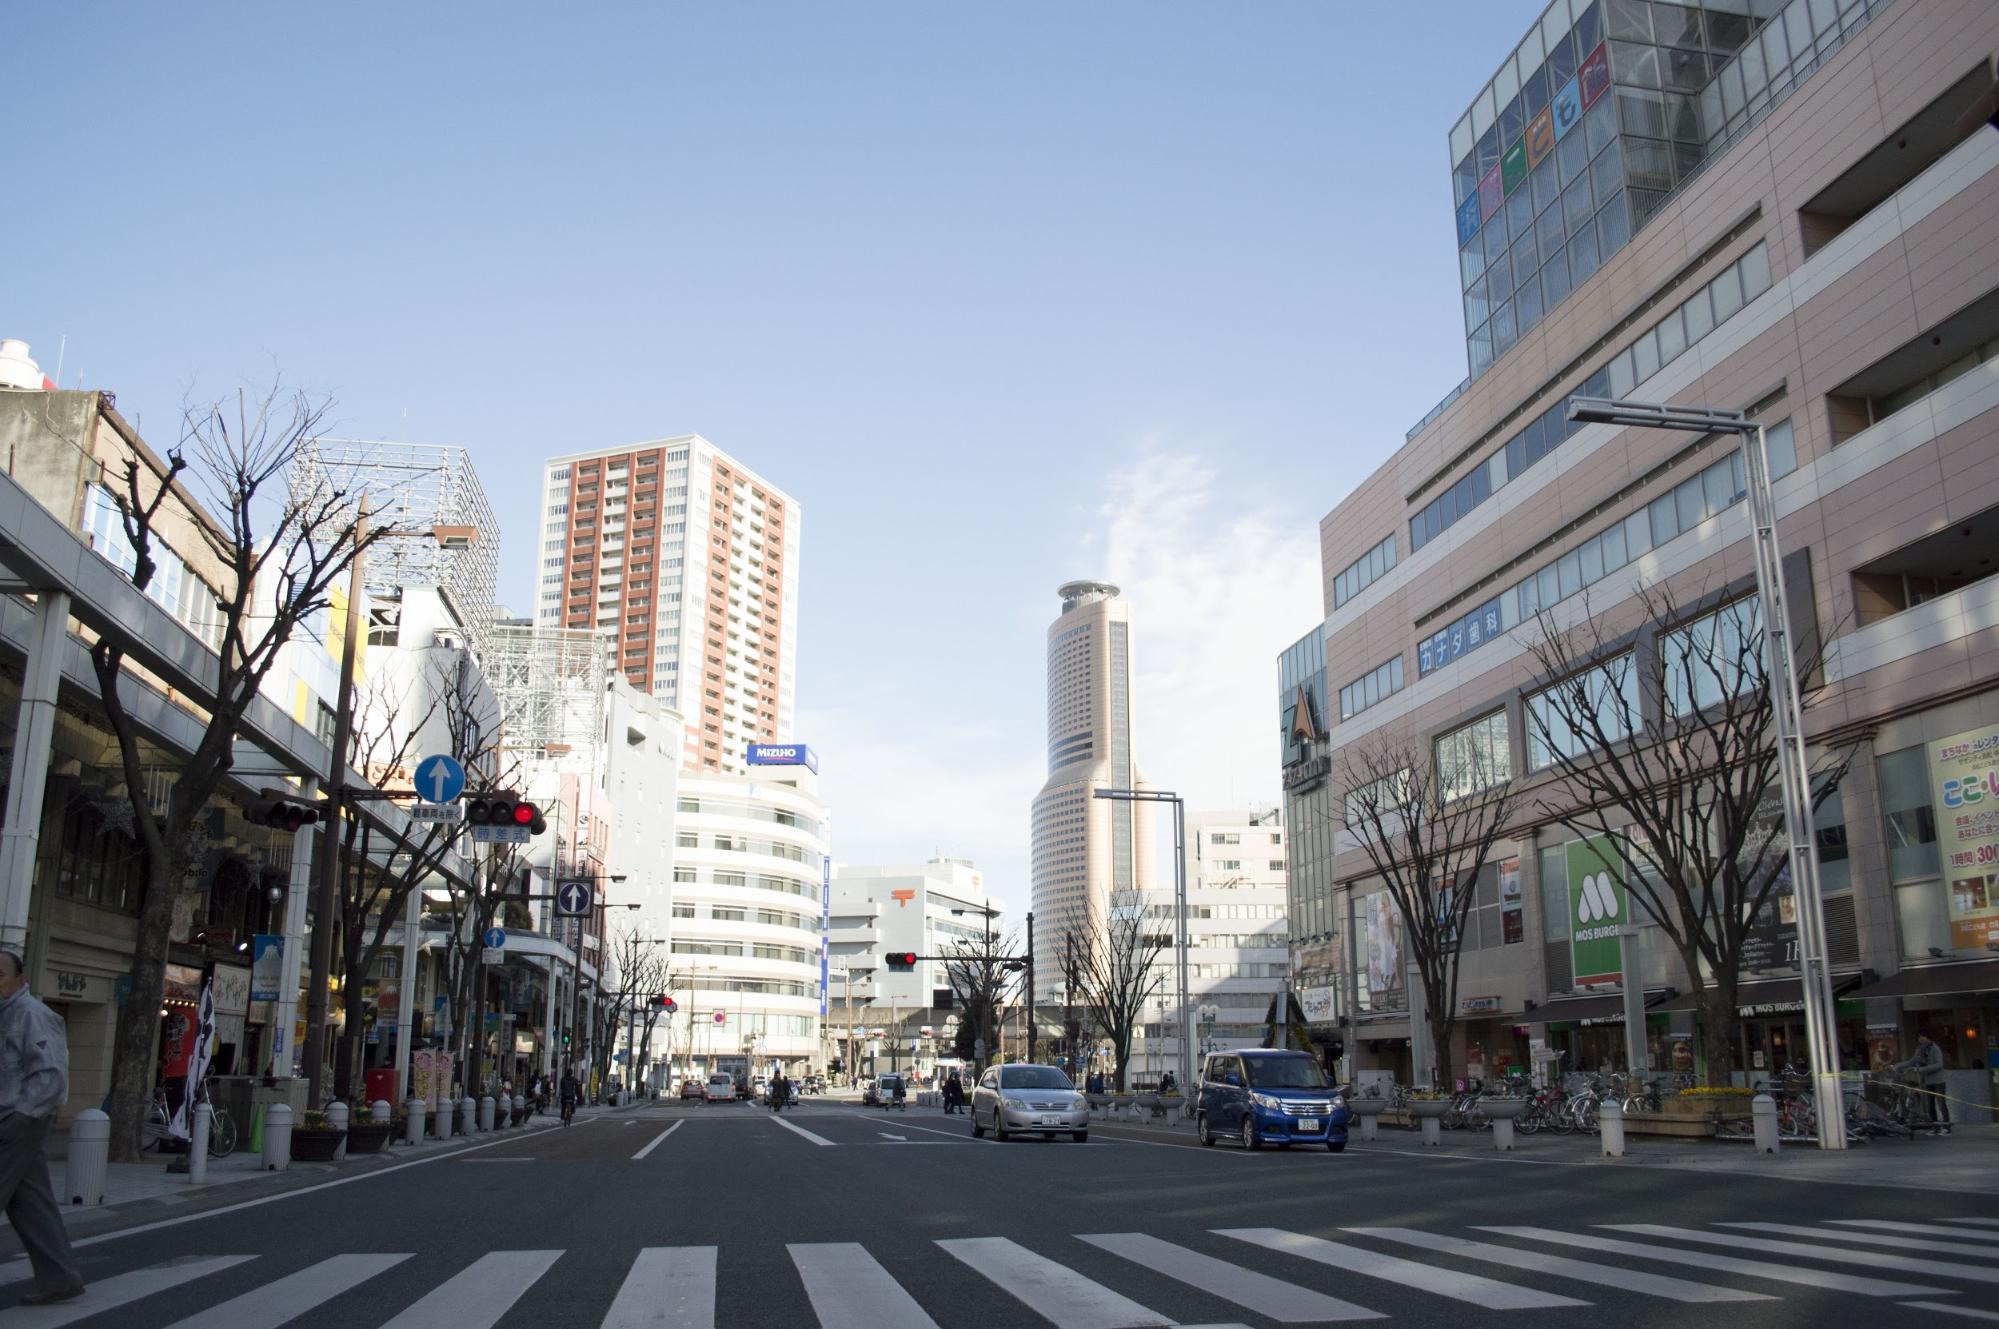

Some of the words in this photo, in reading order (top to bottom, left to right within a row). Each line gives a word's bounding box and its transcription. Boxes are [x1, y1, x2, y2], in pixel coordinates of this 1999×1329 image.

[1421, 609, 1498, 672] カナダ歯科
[757, 748, 796, 757] MIZUHO
[478, 828, 525, 840] 時差式
[1575, 929, 1593, 942] MOS
[1594, 924, 1620, 939] BURGE
